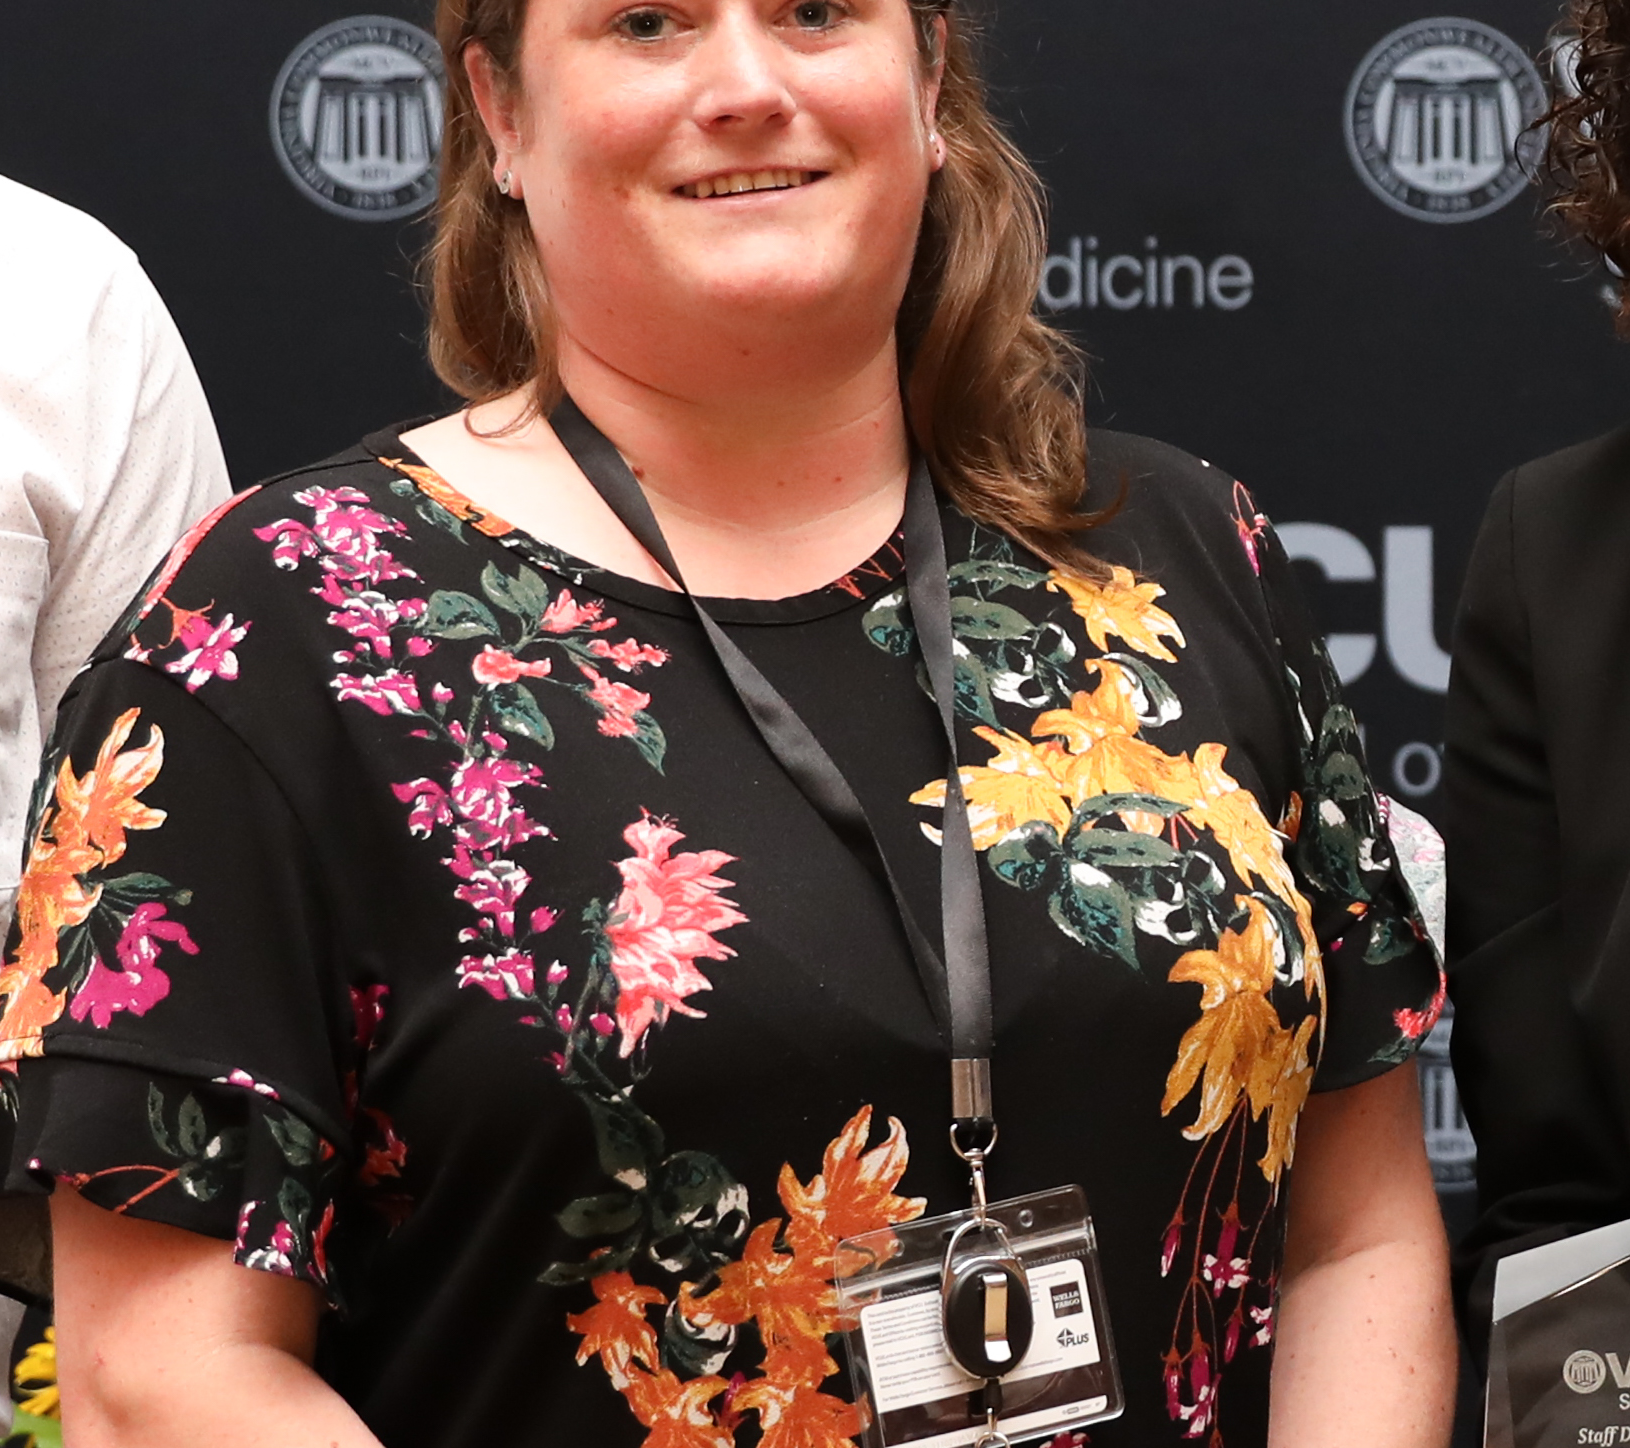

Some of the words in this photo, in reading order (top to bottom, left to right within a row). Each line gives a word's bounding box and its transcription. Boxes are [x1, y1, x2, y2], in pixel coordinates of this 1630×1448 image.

[1038, 235, 1254, 309] dicine
[1066, 1332, 1090, 1348] PLUS
[1577, 1425, 1620, 1447] Staff
